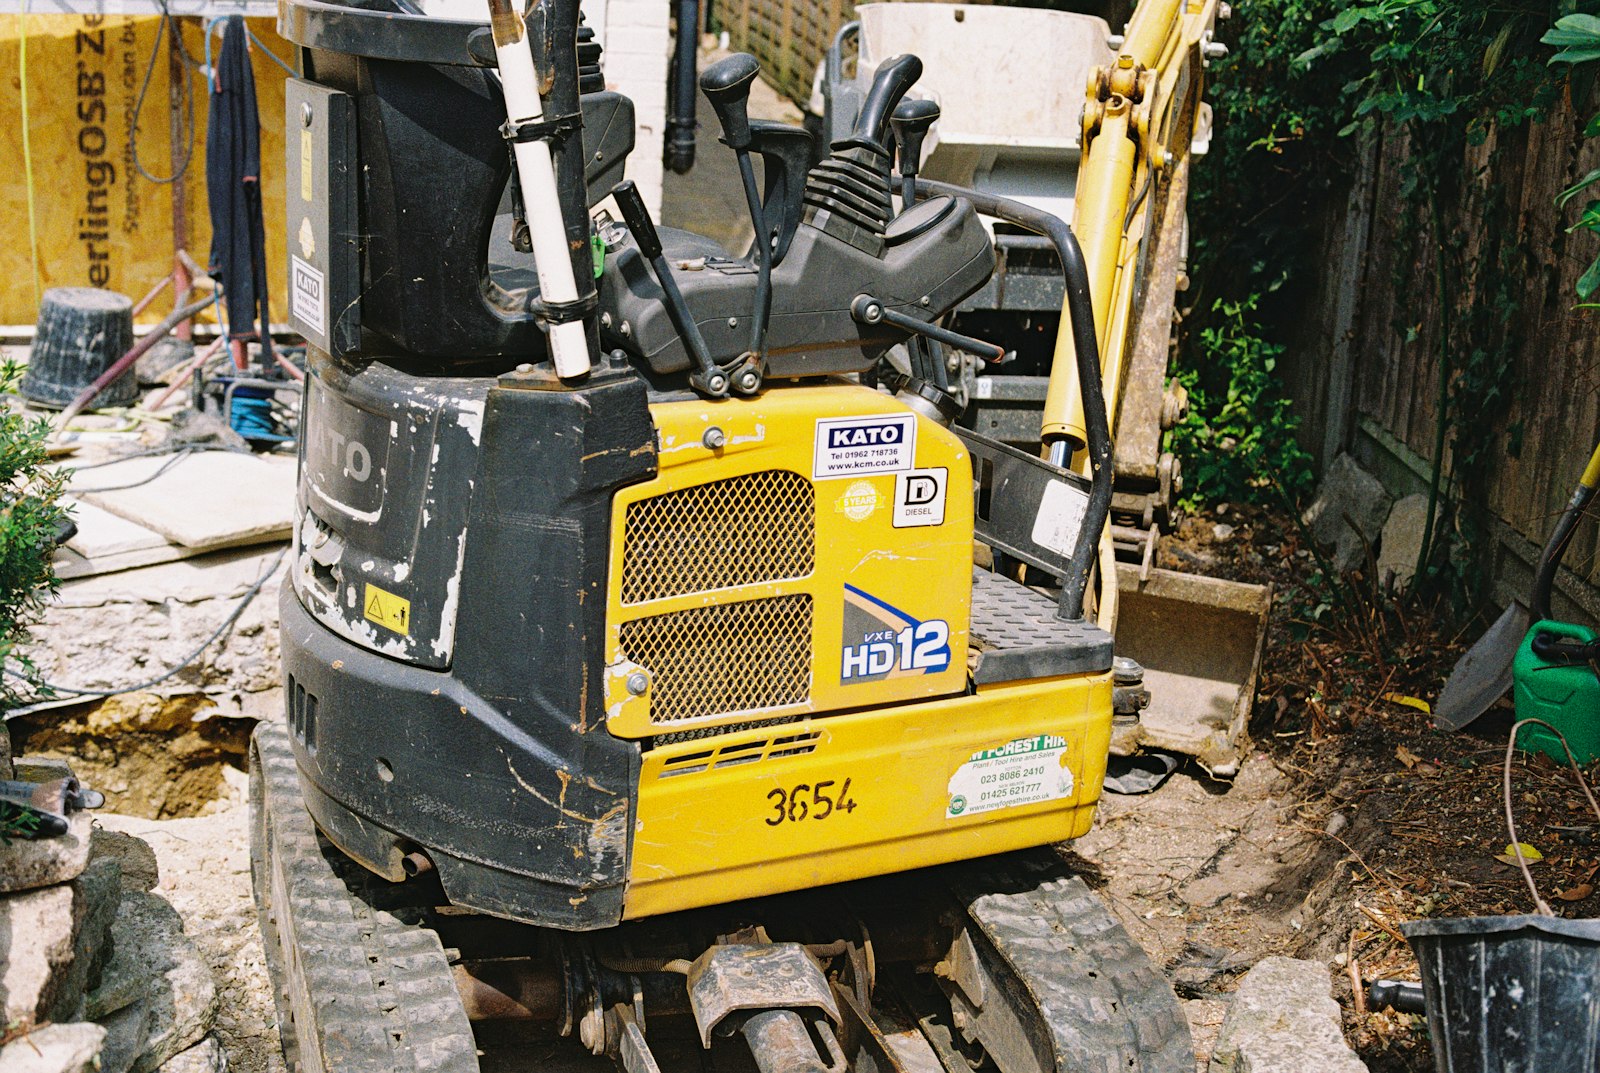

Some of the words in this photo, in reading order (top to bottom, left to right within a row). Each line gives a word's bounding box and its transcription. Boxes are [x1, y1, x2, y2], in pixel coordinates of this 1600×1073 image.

[75, 12, 105, 55] Ze
[122, 51, 136, 89] can
[297, 271, 319, 298] KATO
[832, 426, 899, 446] KATO
[831, 452, 843, 460] Tel
[845, 450, 868, 459] 01962
[871, 448, 898, 457] 718736
[827, 458, 900, 471] www.kcm.co.uk
[843, 497, 849, 506] 5
[850, 495, 877, 506] YEARS
[905, 507, 932, 516] DIESEL
[864, 630, 893, 642] VXE
[986, 737, 1041, 759] FOREST
[1043, 735, 1067, 750] HIR
[972, 761, 989, 770] Plant
[994, 757, 1008, 766] Tool
[1009, 755, 1023, 763] Hire
[1024, 753, 1037, 761] and
[1037, 751, 1055, 759] Sales
[980, 774, 997, 785] 023
[999, 769, 1020, 782] 8086
[1023, 765, 1045, 777] 2410
[980, 788, 1007, 801] 01425
[1009, 782, 1042, 796] 621777
[765, 777, 857, 826] 3654
[968, 793, 1050, 812] www.newforesthire.co.uk
